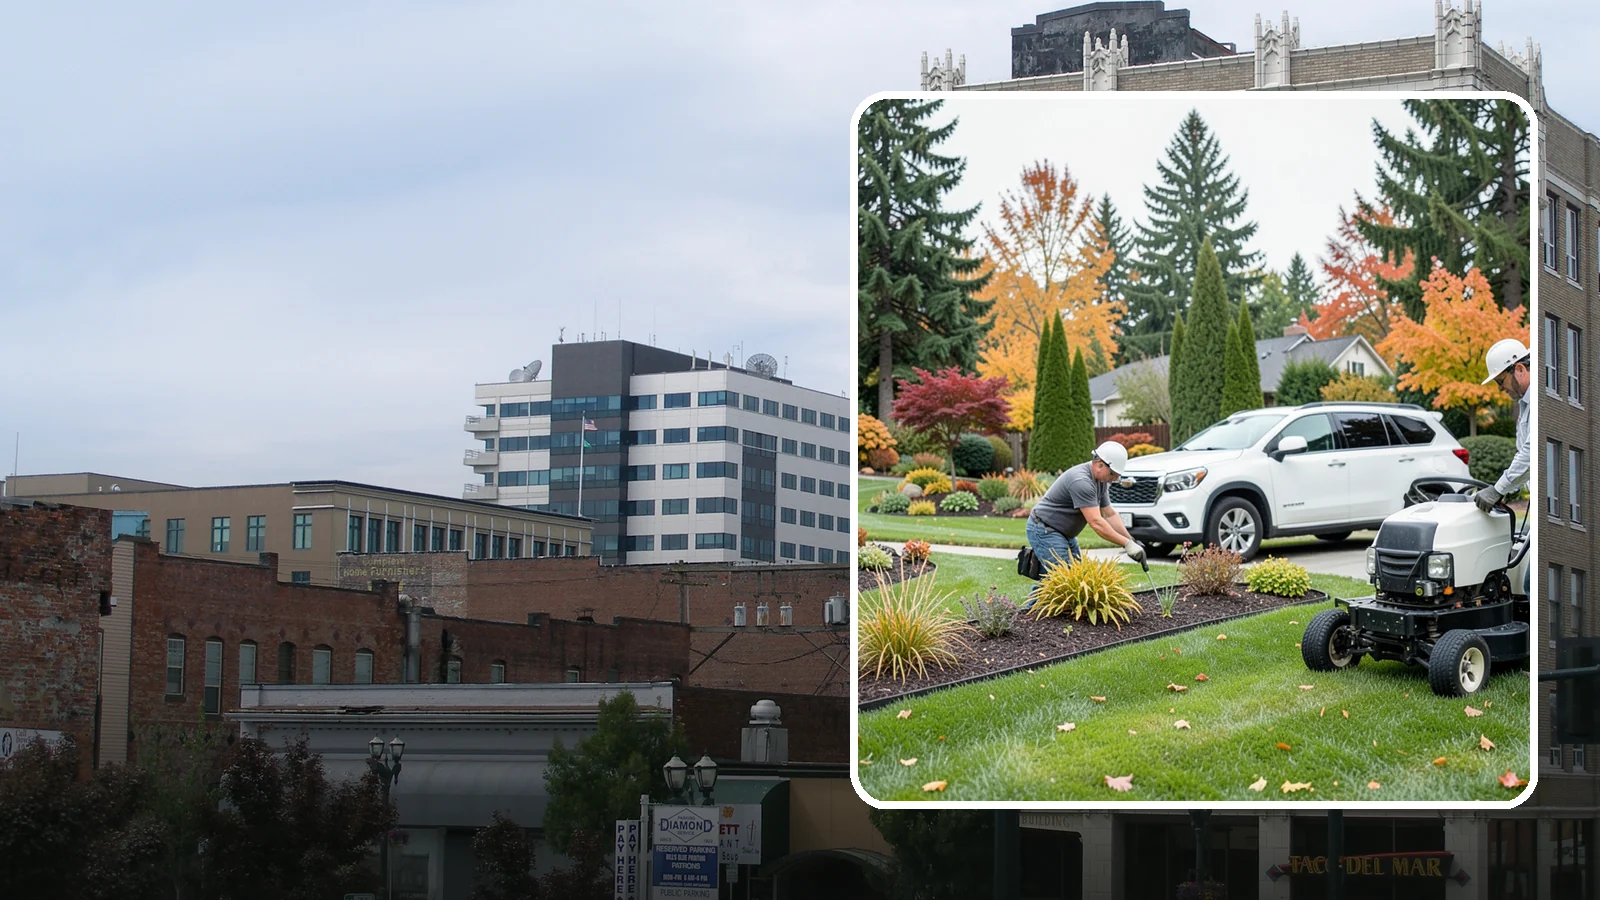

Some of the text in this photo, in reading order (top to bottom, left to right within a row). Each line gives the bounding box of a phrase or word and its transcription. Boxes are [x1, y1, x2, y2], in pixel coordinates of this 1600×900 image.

[660, 818, 713, 833] DIAMOND
[1022, 815, 1070, 827] BUILDING
[616, 825, 625, 893] PAY HERE
[627, 824, 637, 893] PAY HERE
[721, 852, 739, 862] Soup
[1289, 855, 1443, 877] TAC DEL MAR
[660, 889, 710, 898] PUBLIC PARKING
